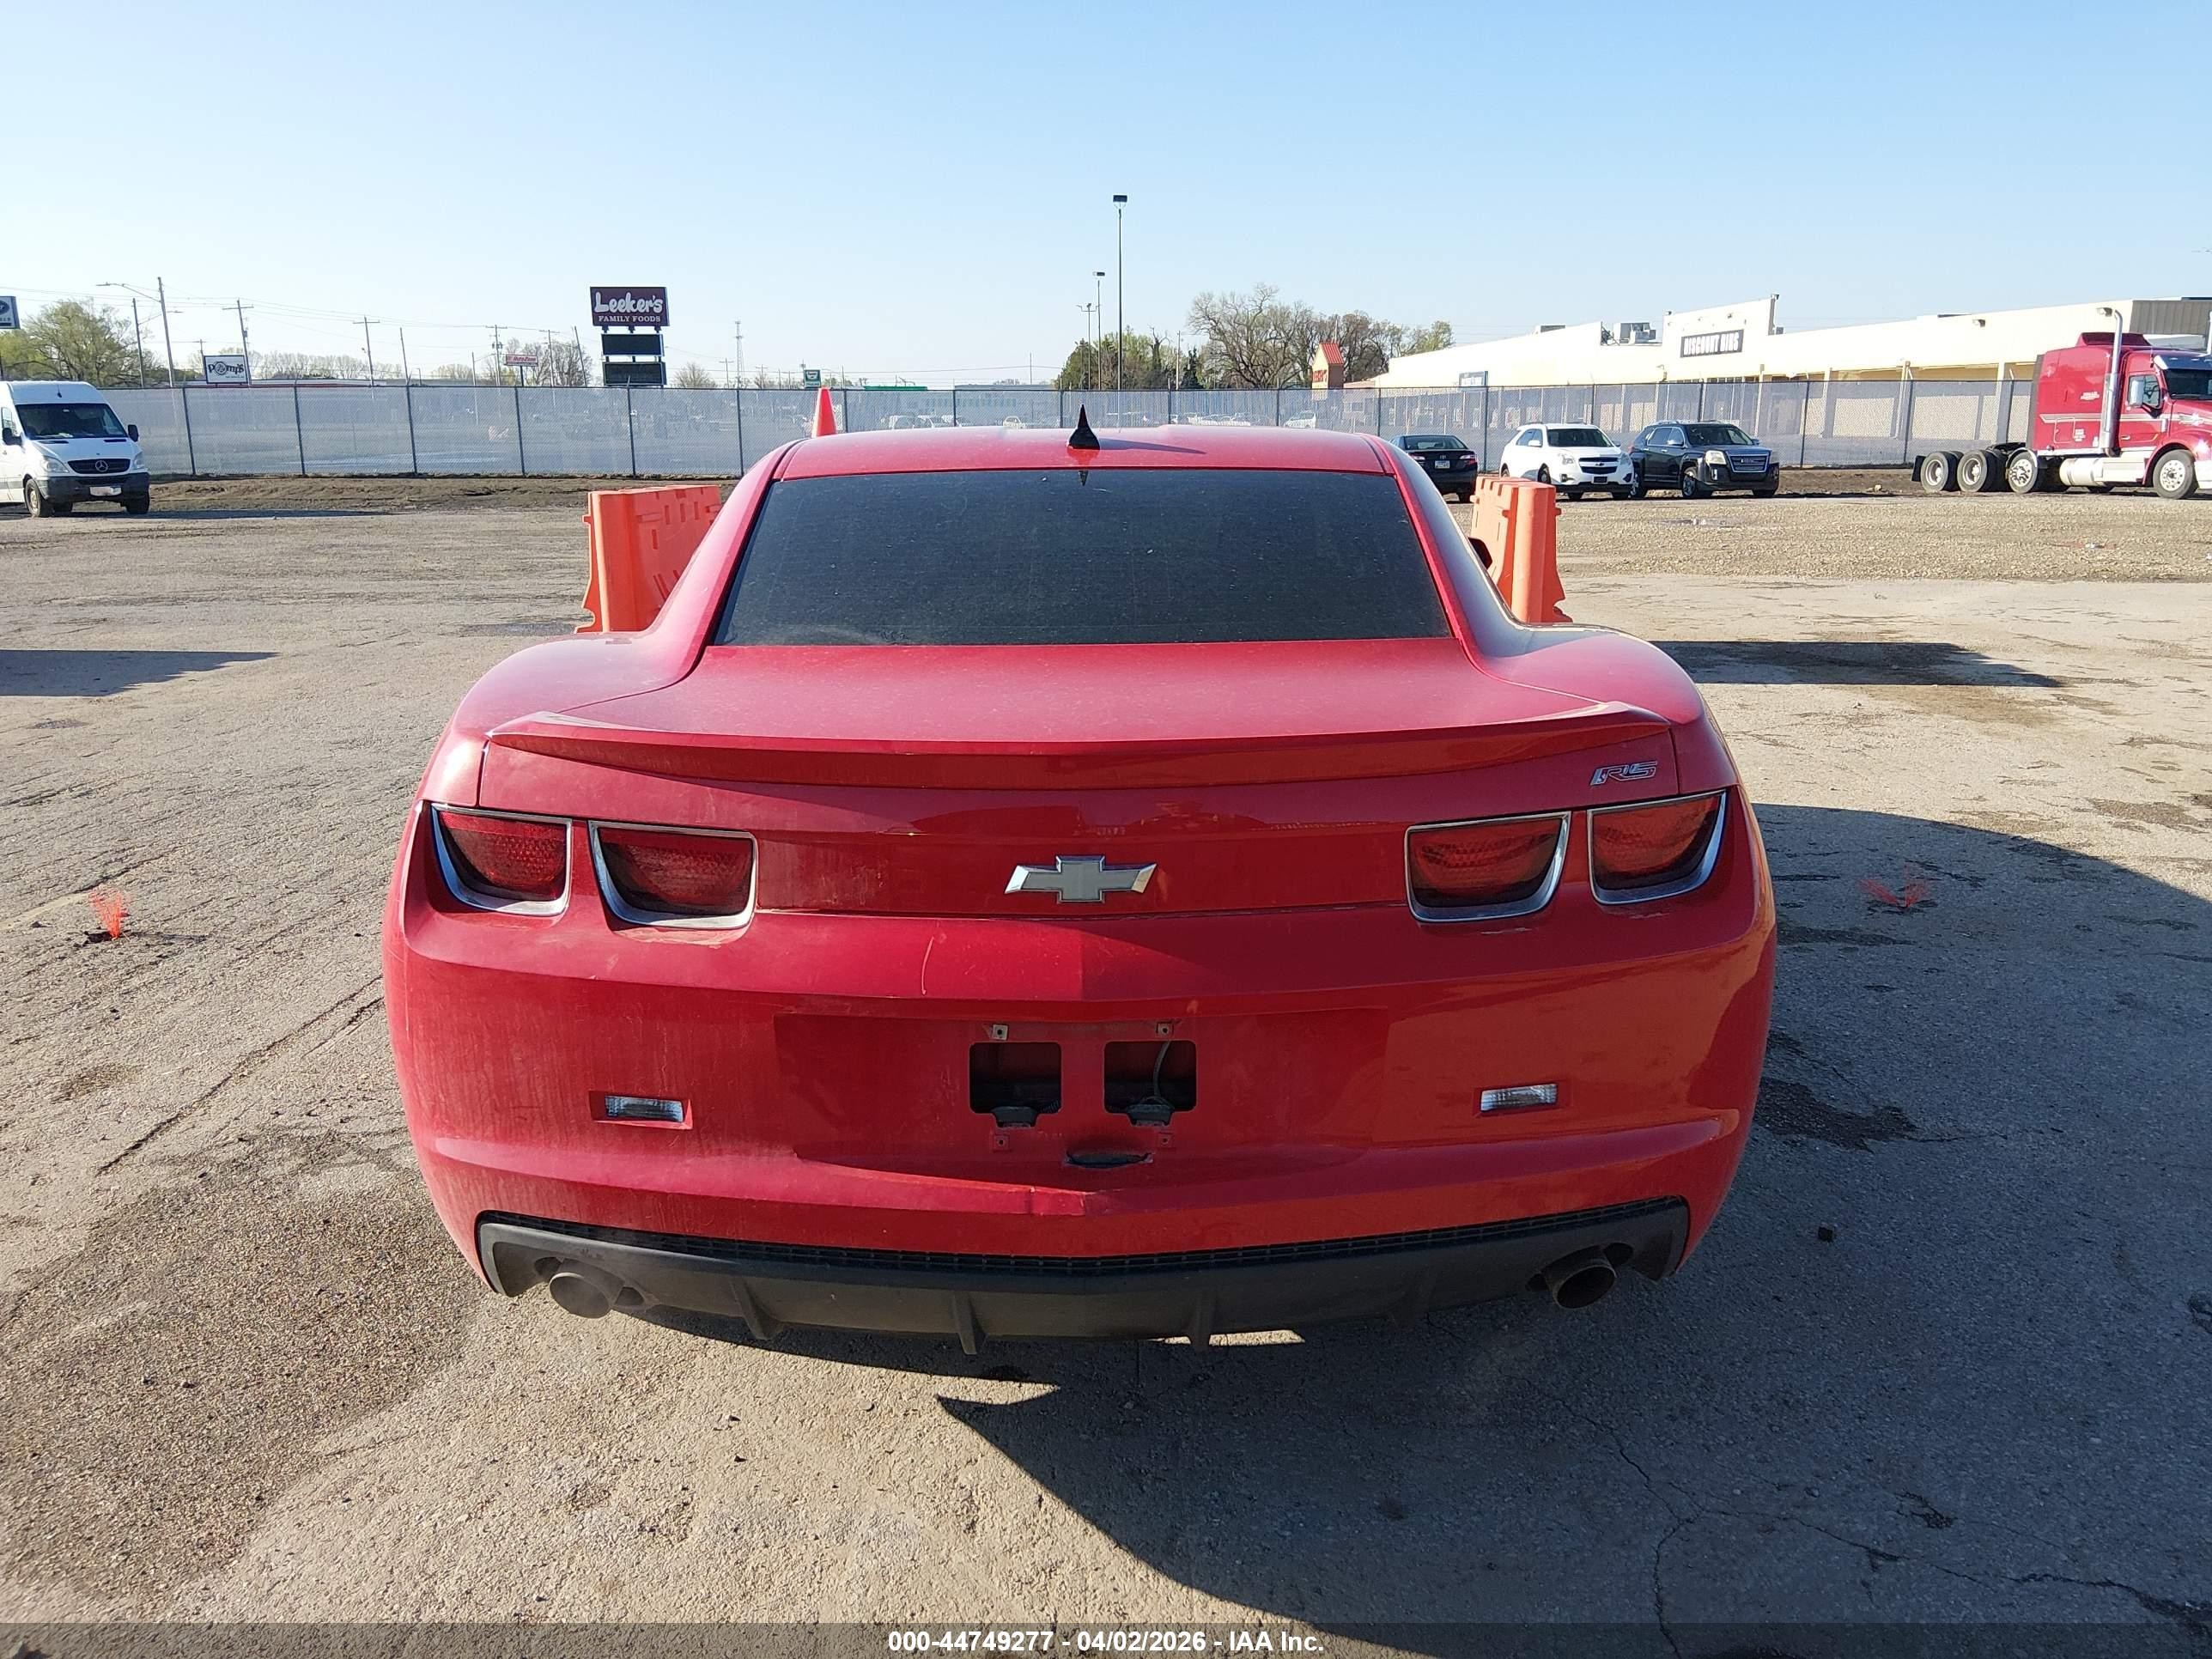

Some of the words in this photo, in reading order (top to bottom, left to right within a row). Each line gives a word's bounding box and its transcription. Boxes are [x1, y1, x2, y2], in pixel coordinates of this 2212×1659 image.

[594, 292, 664, 313] Leeker's
[1683, 335, 1720, 356] DISCOUNT
[1590, 761, 1658, 786] RS
